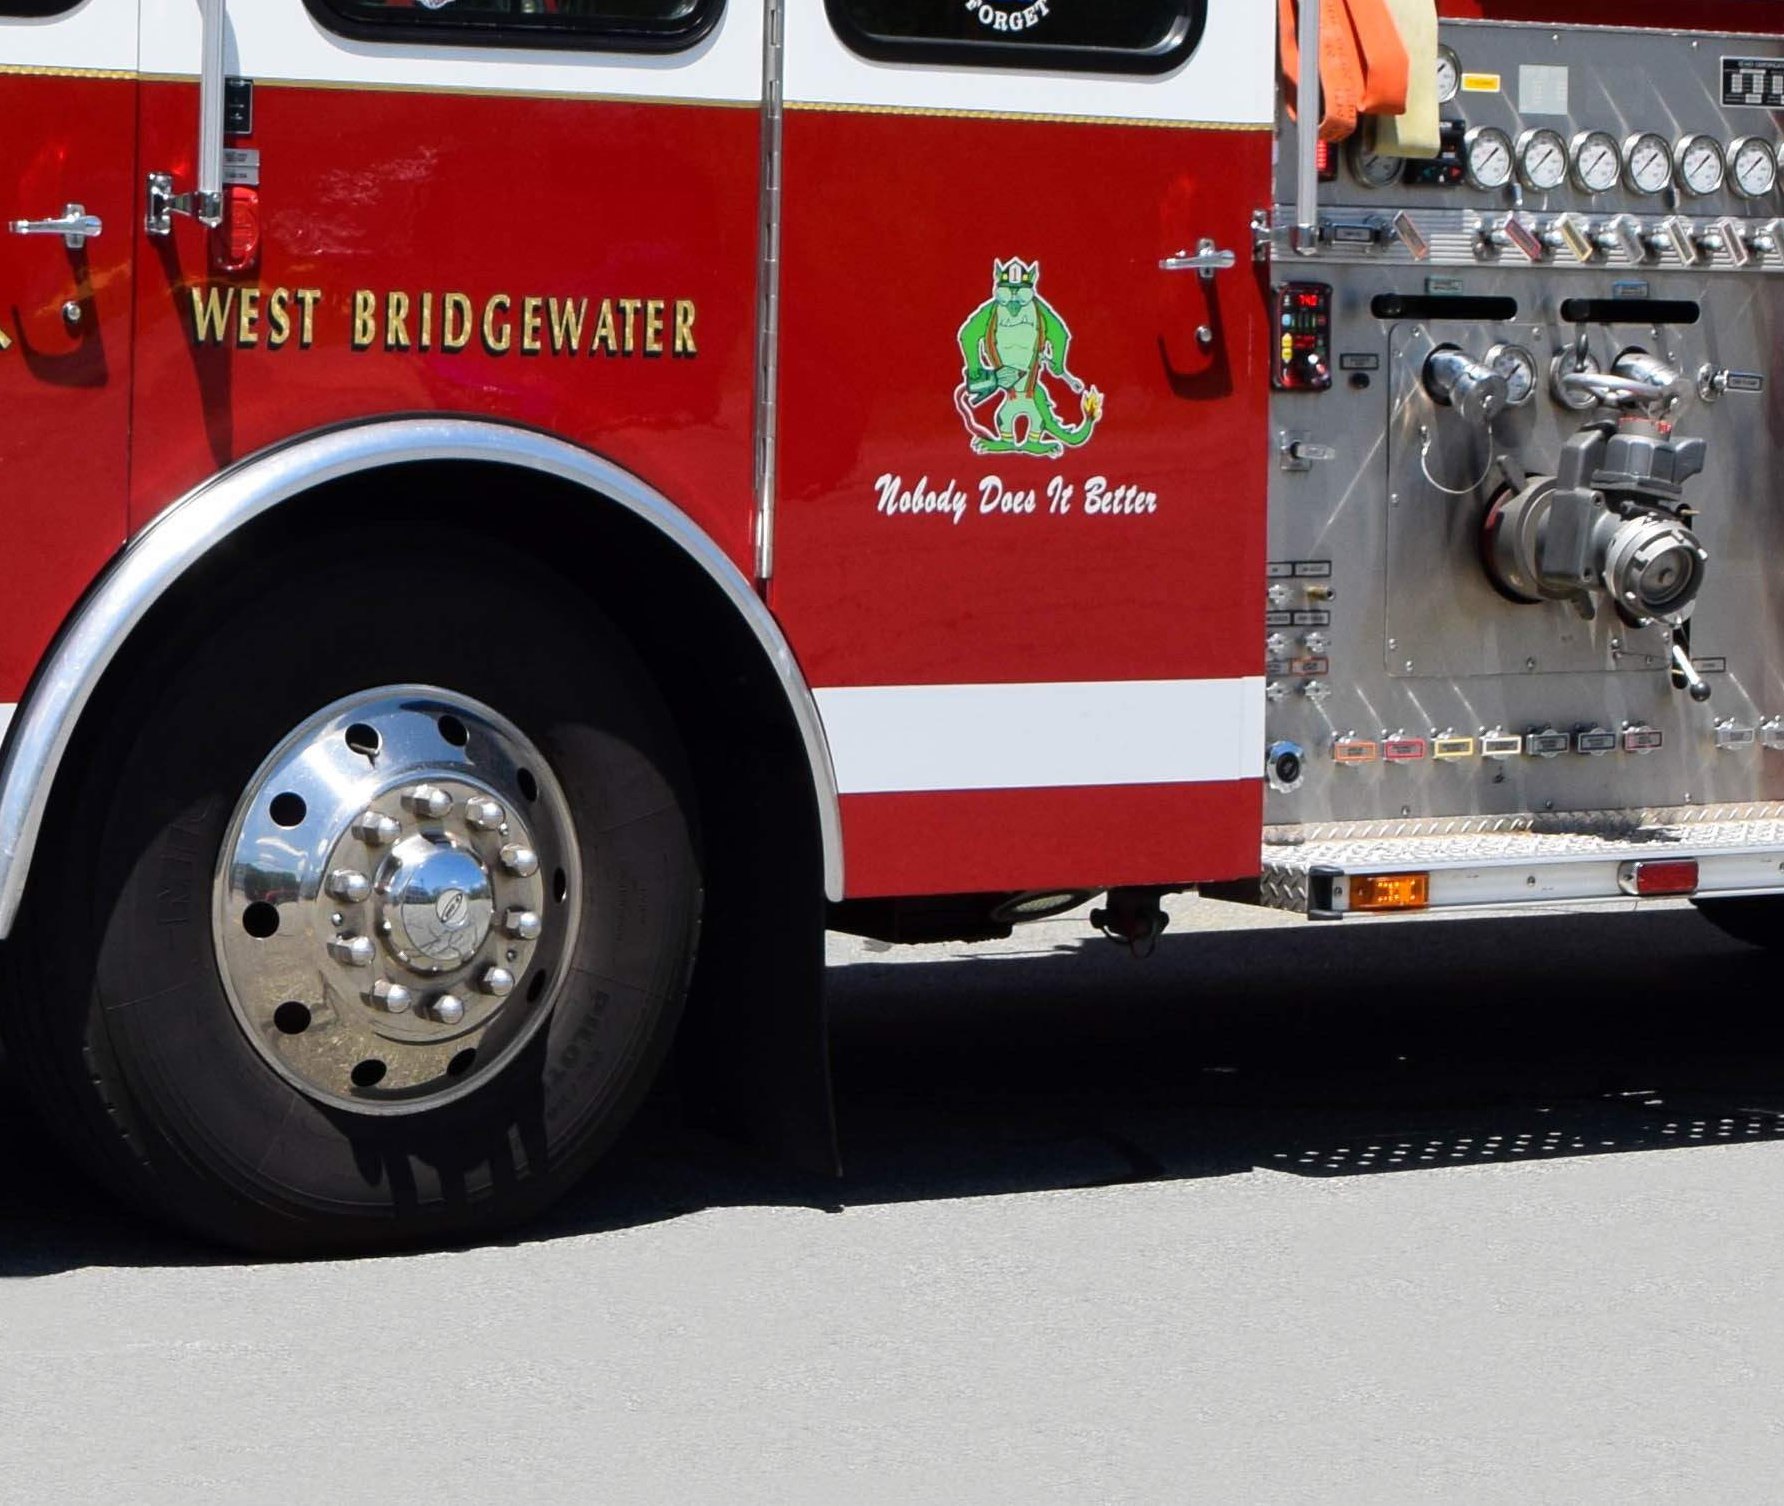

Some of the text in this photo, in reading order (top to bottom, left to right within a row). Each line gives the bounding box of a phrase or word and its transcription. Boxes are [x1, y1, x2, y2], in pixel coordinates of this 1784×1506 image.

[189, 286, 699, 359] WEST BRIDGEWATER
[874, 473, 1158, 525] Nobody Does It Better
